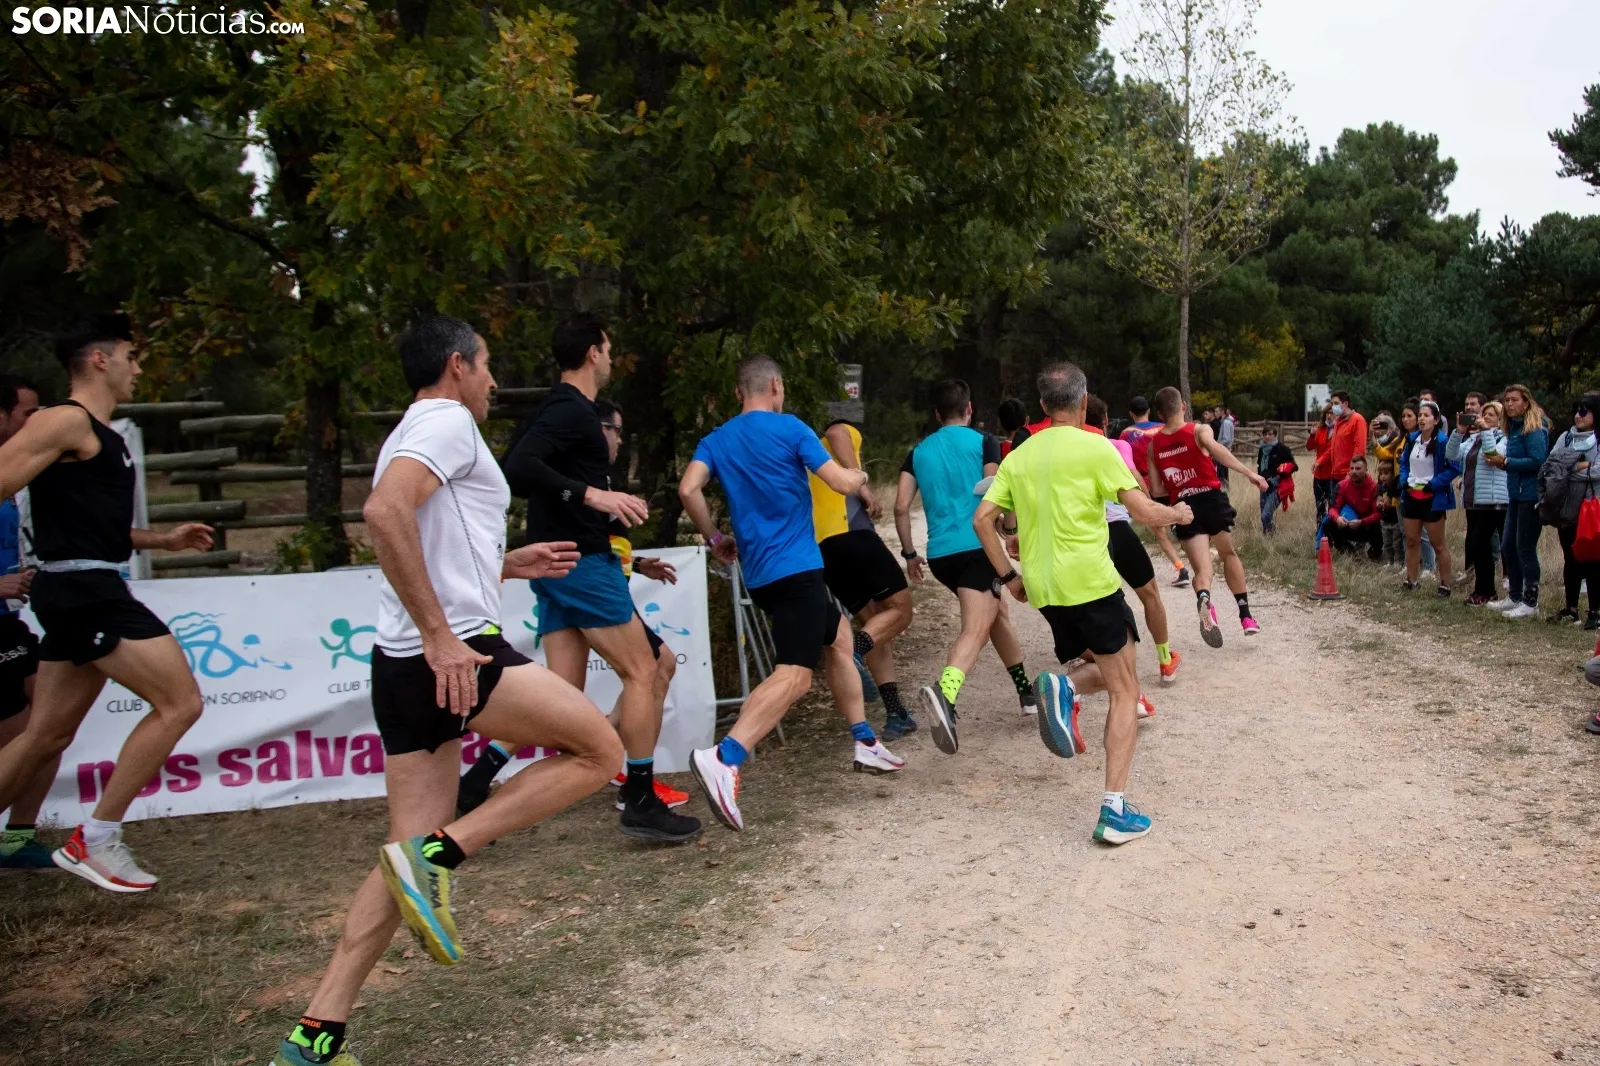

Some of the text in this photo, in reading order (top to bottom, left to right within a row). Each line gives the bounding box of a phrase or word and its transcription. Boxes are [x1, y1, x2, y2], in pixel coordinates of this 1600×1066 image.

[328, 680, 360, 694] CLUB
[106, 699, 143, 713] CLUB
[221, 688, 287, 705] SORIANO
